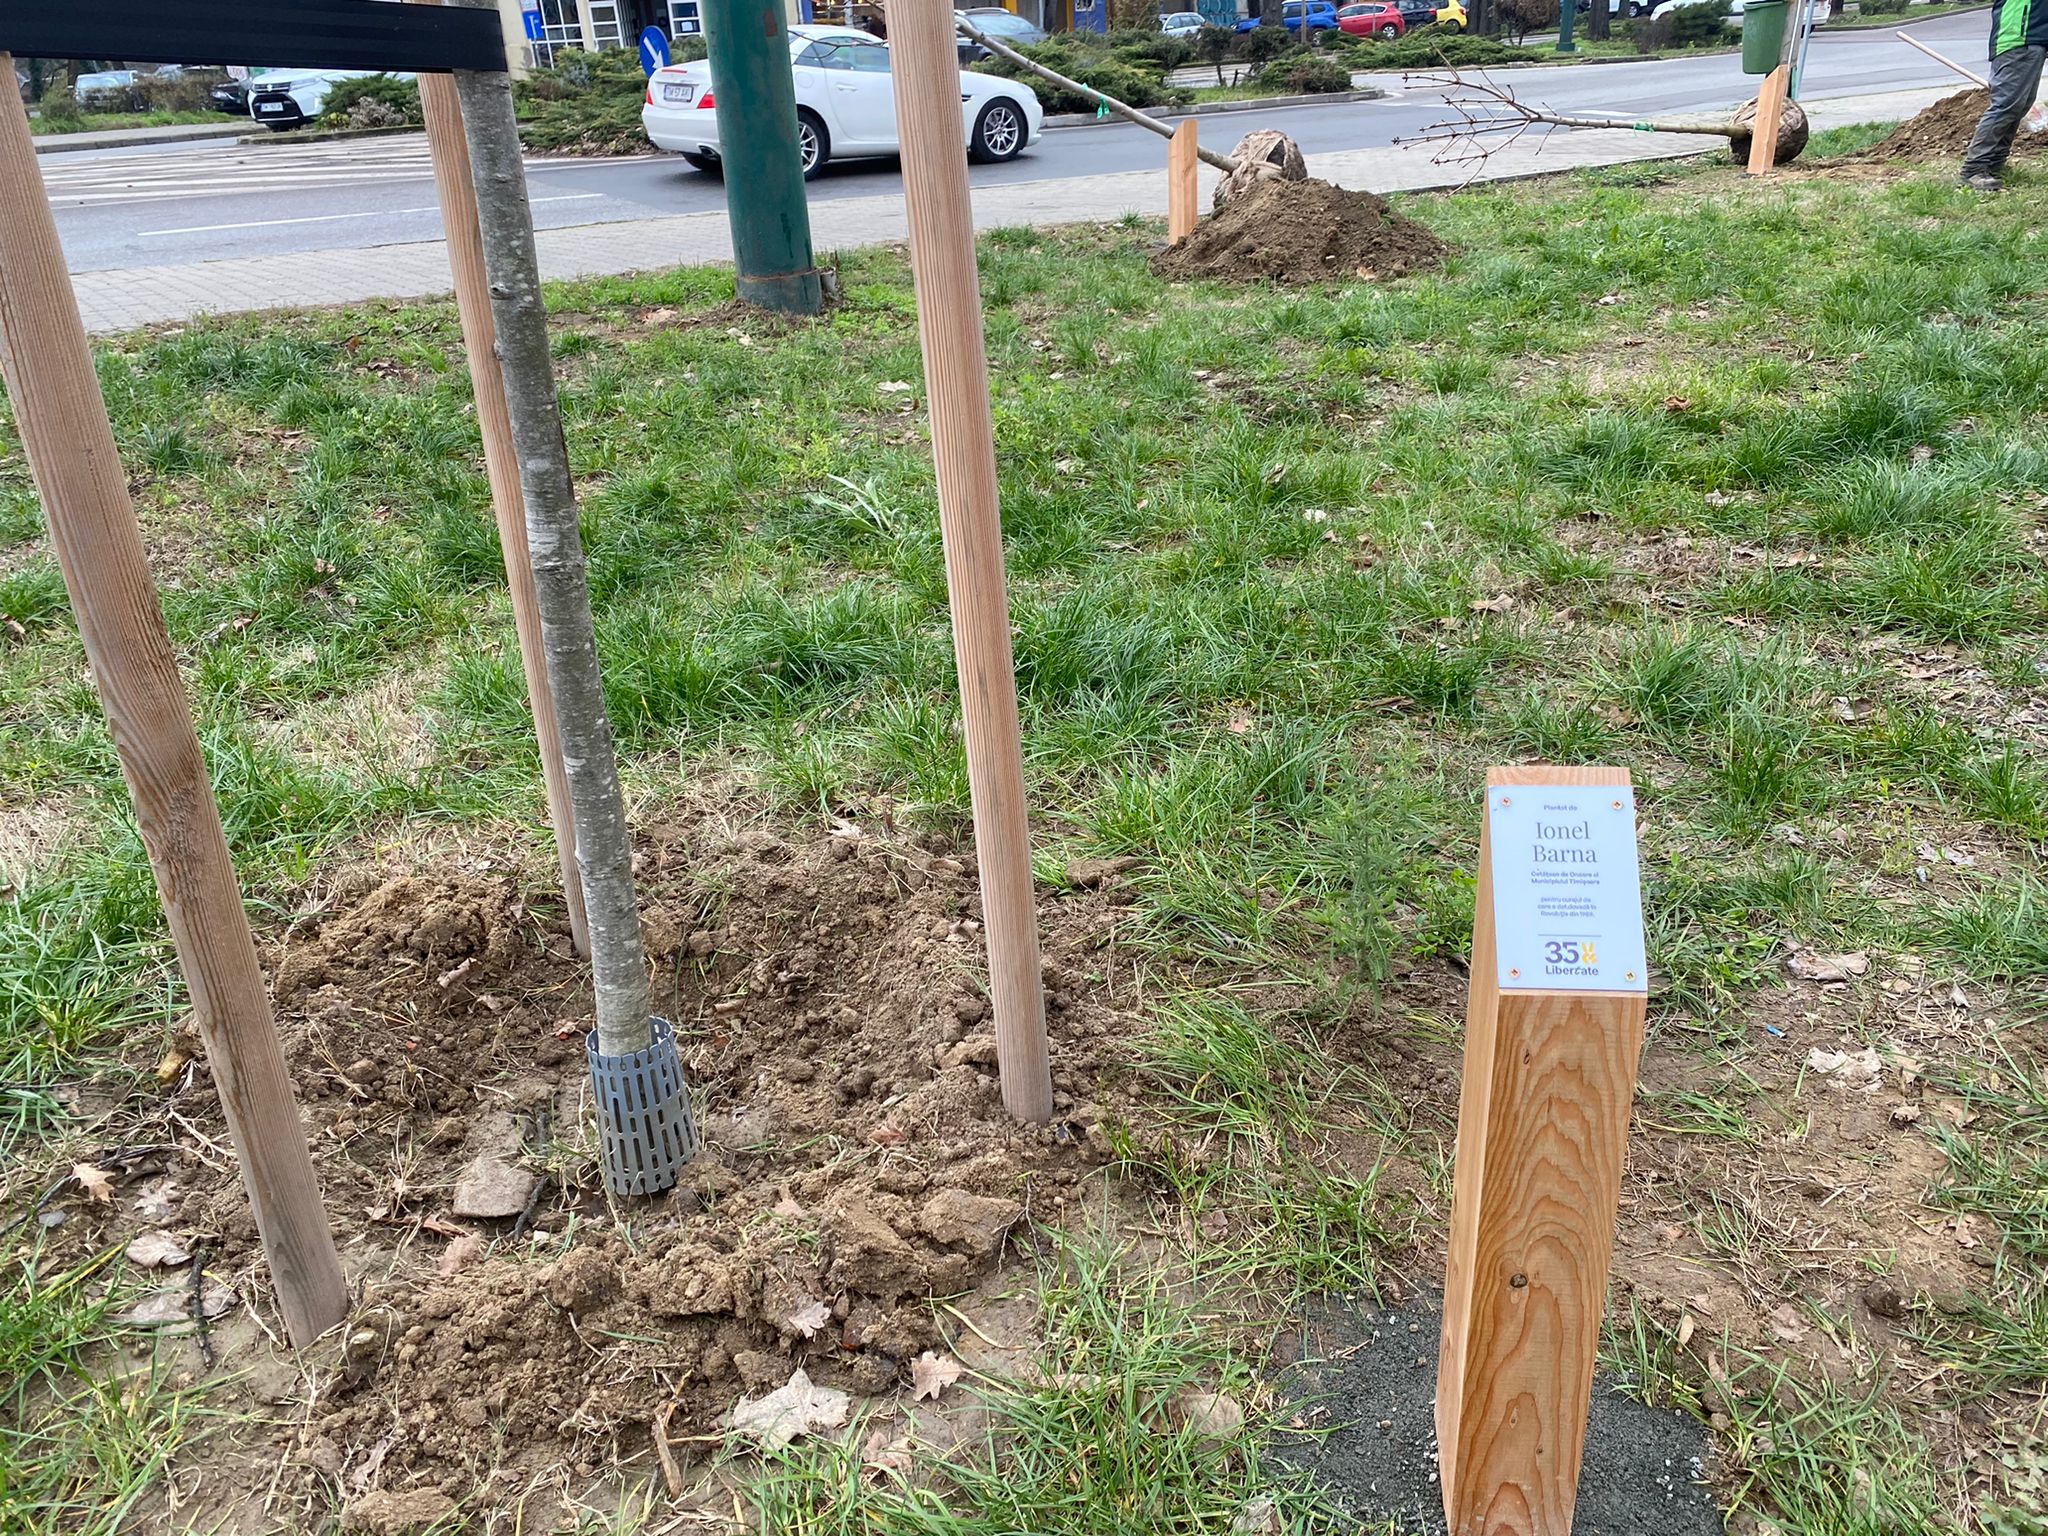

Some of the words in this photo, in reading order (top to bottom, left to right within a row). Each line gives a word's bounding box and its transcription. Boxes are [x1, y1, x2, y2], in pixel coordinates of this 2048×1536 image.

[1536, 821, 1591, 840] Ionel
[1532, 844, 1597, 863] Barna
[1545, 941, 1579, 964] 35
[1546, 965, 1598, 976] Libertate
